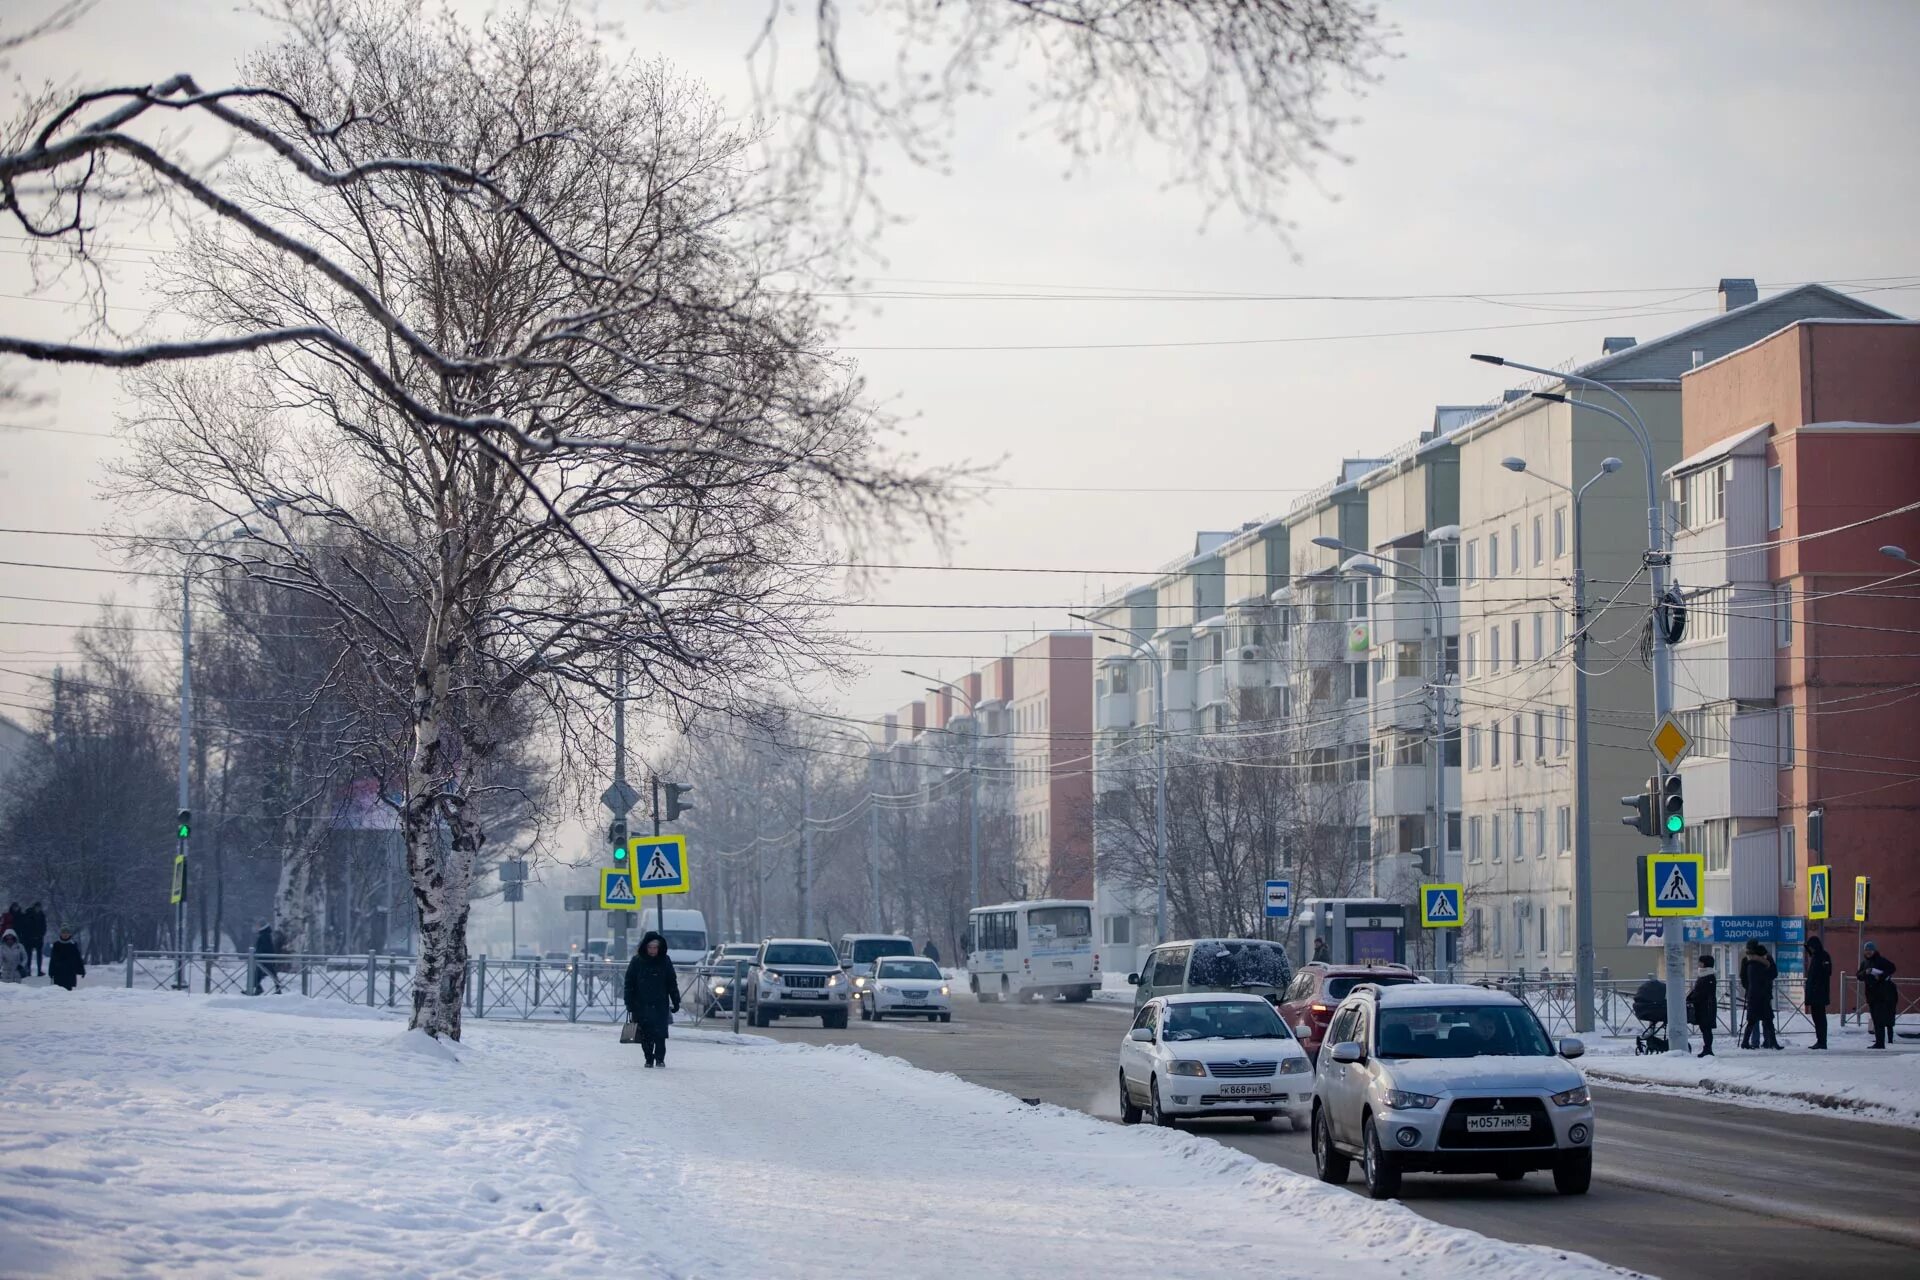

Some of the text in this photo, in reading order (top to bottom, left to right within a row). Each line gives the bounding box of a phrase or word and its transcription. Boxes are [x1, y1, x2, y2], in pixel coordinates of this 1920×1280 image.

[1721, 920, 1755, 928] ТОВАРЫ
[1756, 920, 1774, 928] ДЛЯ
[1724, 930, 1769, 938] ЗДОРОВЬЯ
